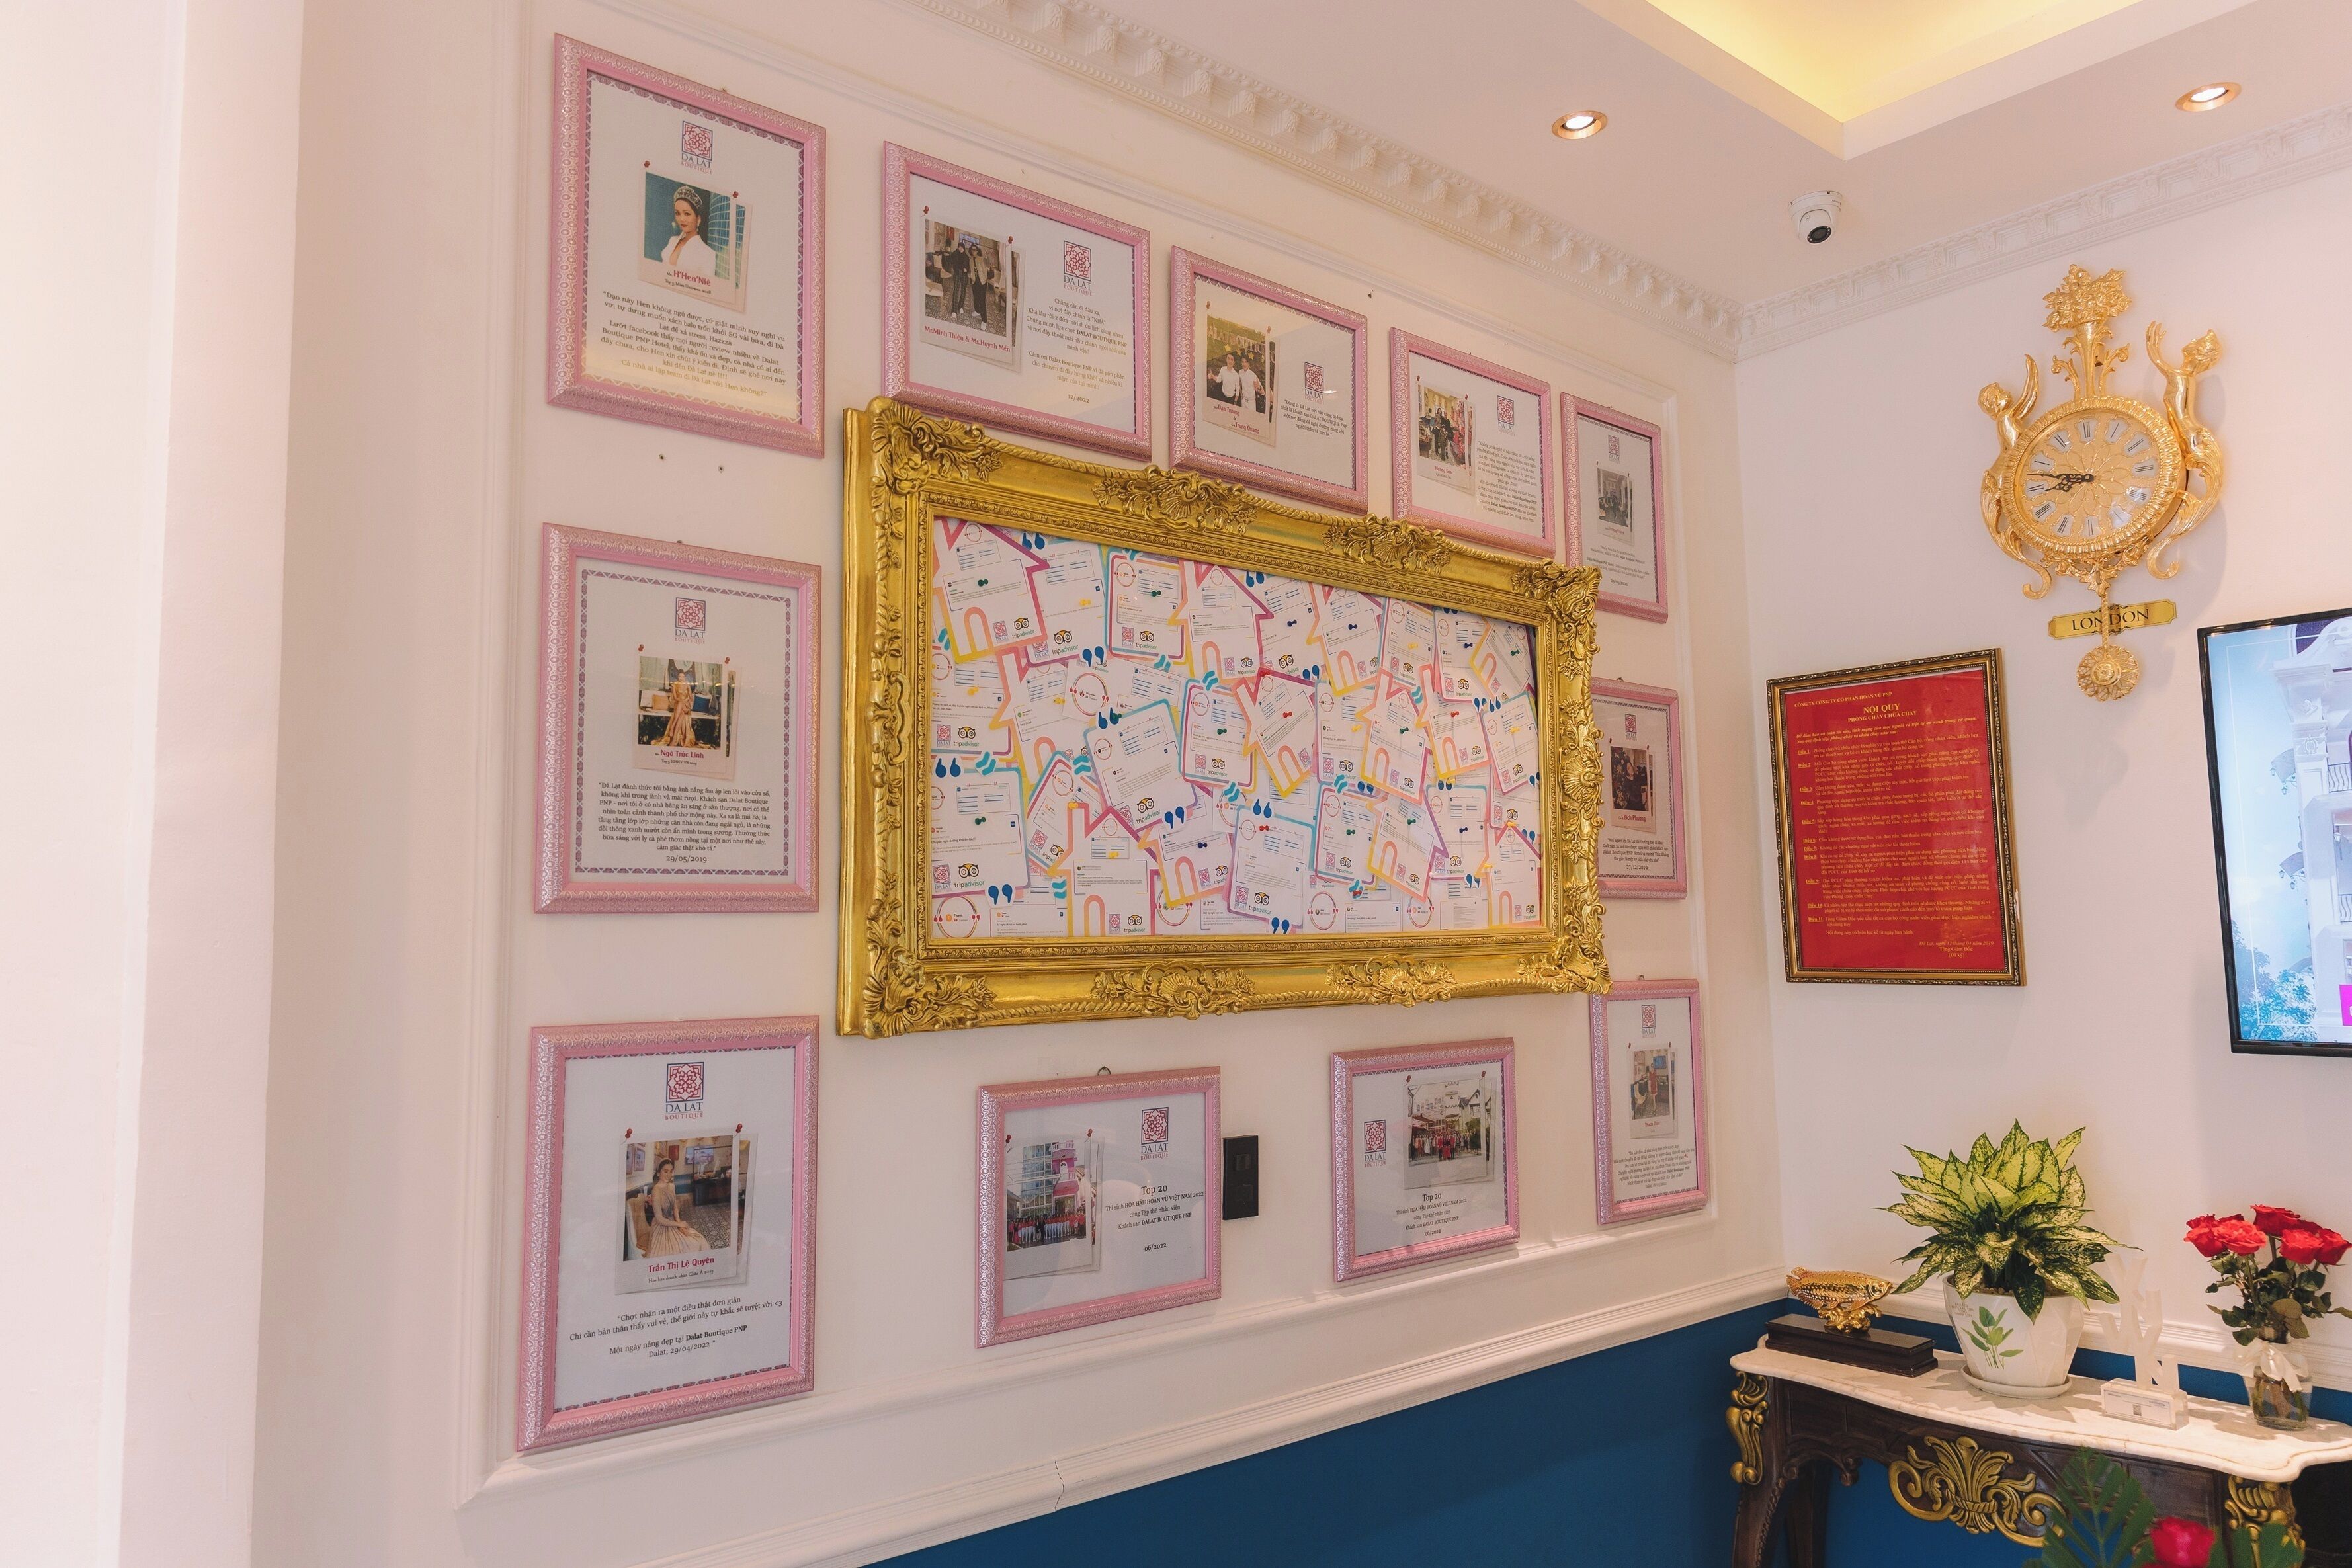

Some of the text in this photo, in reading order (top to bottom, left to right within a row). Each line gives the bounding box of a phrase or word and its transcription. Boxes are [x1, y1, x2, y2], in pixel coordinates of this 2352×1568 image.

[2072, 608, 2149, 630] LONDON
[1011, 629, 1035, 640] tripadvisor
[1052, 645, 1079, 655] tripadvisor
[1206, 768, 1228, 777] tripadvisor
[744, 797, 769, 805] Boutique
[1136, 809, 1161, 825] tripadvisor
[665, 854, 707, 864] 29/05/2019
[954, 880, 985, 889] tripadvisor
[1249, 905, 1272, 915] tripadvisor
[665, 1101, 703, 1113] DA LAT
[664, 1112, 703, 1120] BOUTIQUE
[1140, 1152, 1168, 1161] BOUTIQUE
[1157, 1213, 1182, 1223] BOUTIQUE
[667, 1260, 679, 1270] Thị
[681, 1259, 689, 1268] Lệ
[691, 1257, 714, 1266] Quyên
[639, 1309, 656, 1319] nhận
[666, 1305, 680, 1314] một
[681, 1303, 696, 1311] điều
[697, 1300, 710, 1309] thật
[583, 1329, 596, 1338] cần
[597, 1327, 610, 1336] bản
[612, 1325, 628, 1333] thân
[630, 1321, 645, 1330] thấy
[669, 1314, 681, 1323] thế
[682, 1313, 695, 1323] giới
[696, 1311, 709, 1319] này
[720, 1306, 735, 1315] khắc
[744, 1302, 761, 1312] tuyệt
[609, 1346, 622, 1354] Một
[624, 1343, 641, 1352] ngày
[642, 1339, 659, 1348] nắng
[675, 1335, 684, 1343] tại
[704, 1328, 733, 1338] Boutique
[734, 1324, 747, 1333] PNP
[648, 1348, 668, 1358] Dalat,
[669, 1341, 710, 1354] 29/04/2022
